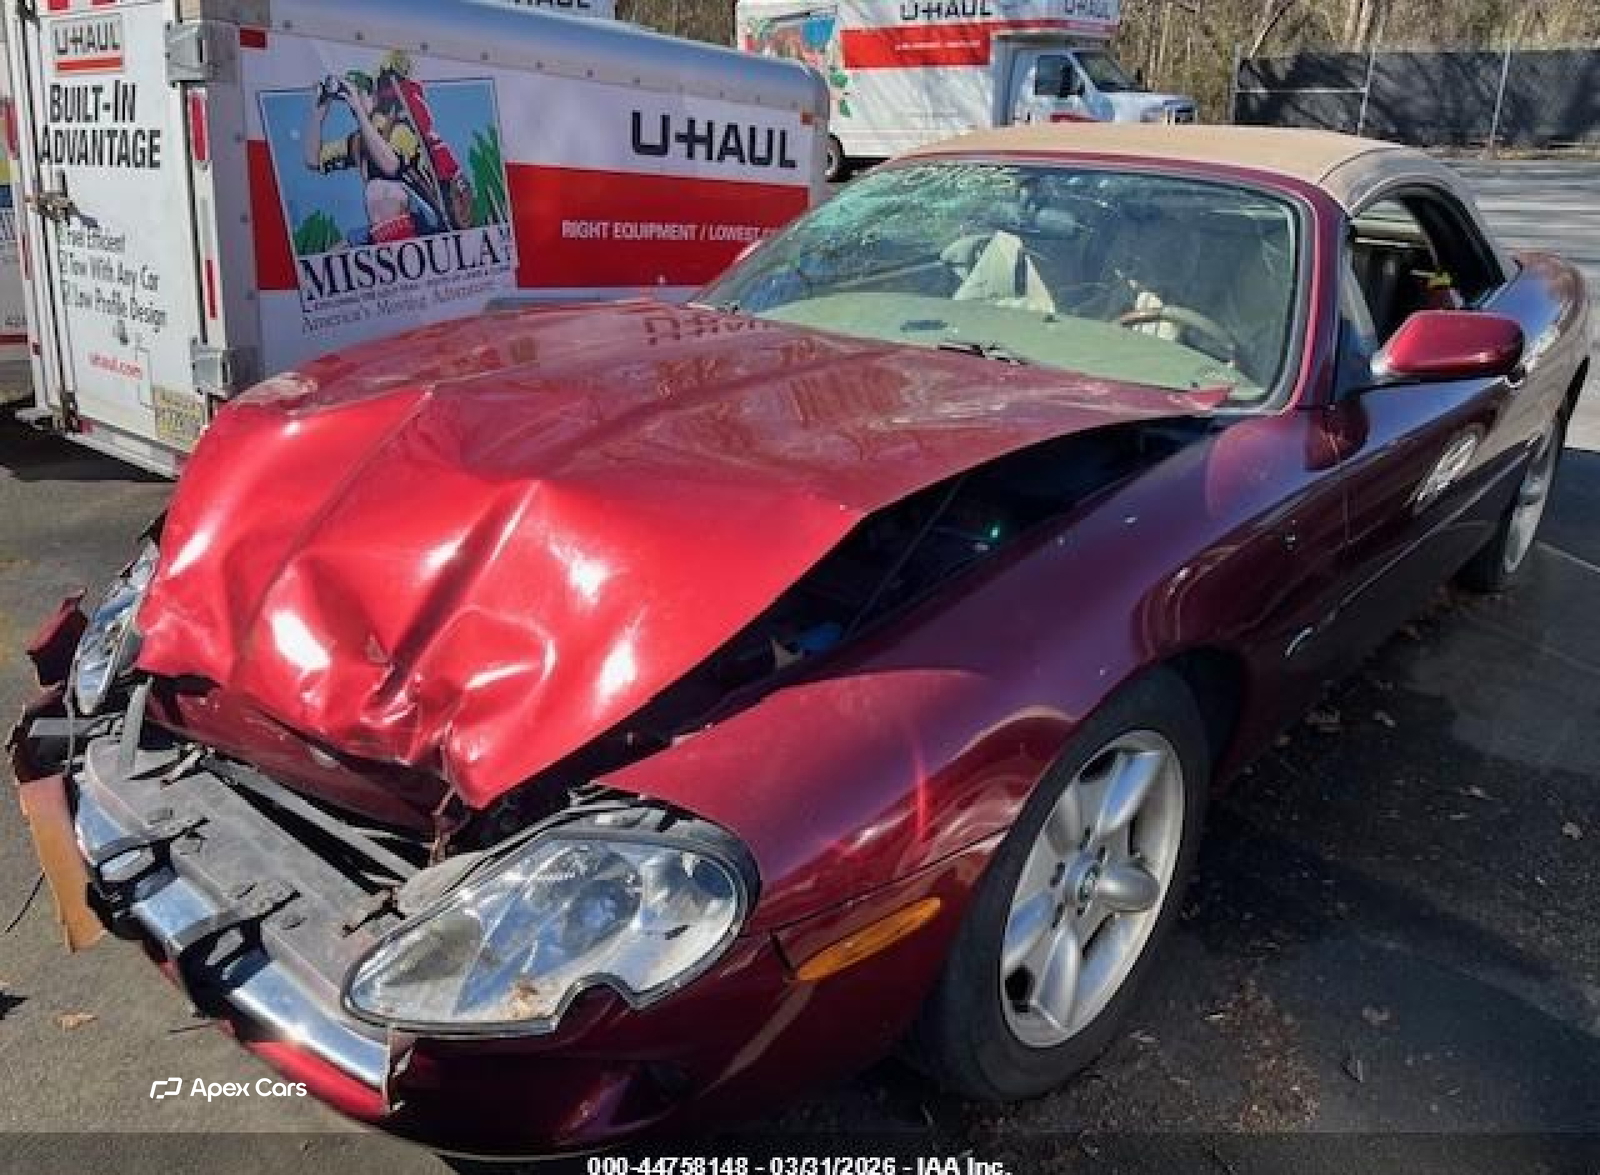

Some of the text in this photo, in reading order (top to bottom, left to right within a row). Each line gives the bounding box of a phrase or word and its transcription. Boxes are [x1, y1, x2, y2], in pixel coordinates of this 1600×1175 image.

[902, 0, 993, 21] U-HAUL
[54, 21, 120, 55] U-HAUL
[50, 80, 136, 123] BUILT-IN
[40, 124, 160, 168] ADVANTAGE
[631, 109, 797, 168] U-HAUL
[561, 219, 611, 240] RIGHT
[613, 221, 699, 241] EQUIPMENT
[708, 224, 761, 241] LOWEST
[299, 229, 501, 301] MISSOULA
[95, 286, 128, 317] Profile
[129, 296, 168, 333] Design
